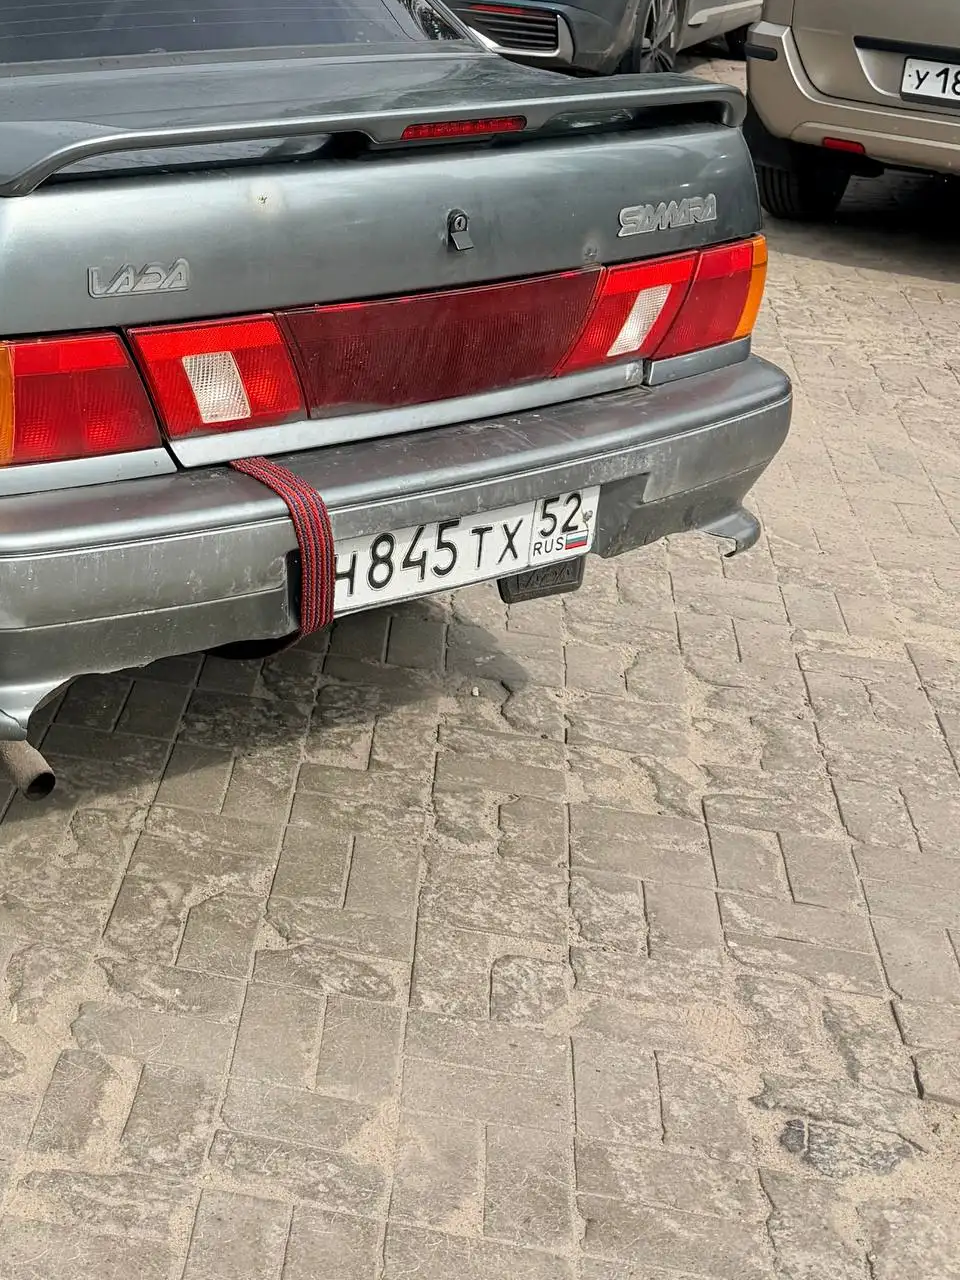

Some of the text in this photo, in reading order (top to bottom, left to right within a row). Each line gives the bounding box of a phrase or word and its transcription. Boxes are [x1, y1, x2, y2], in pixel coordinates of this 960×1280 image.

[617, 193, 717, 237] SAMARA
[86, 258, 190, 299] LADA
[539, 492, 583, 538] 52
[531, 535, 565, 558] RUS
